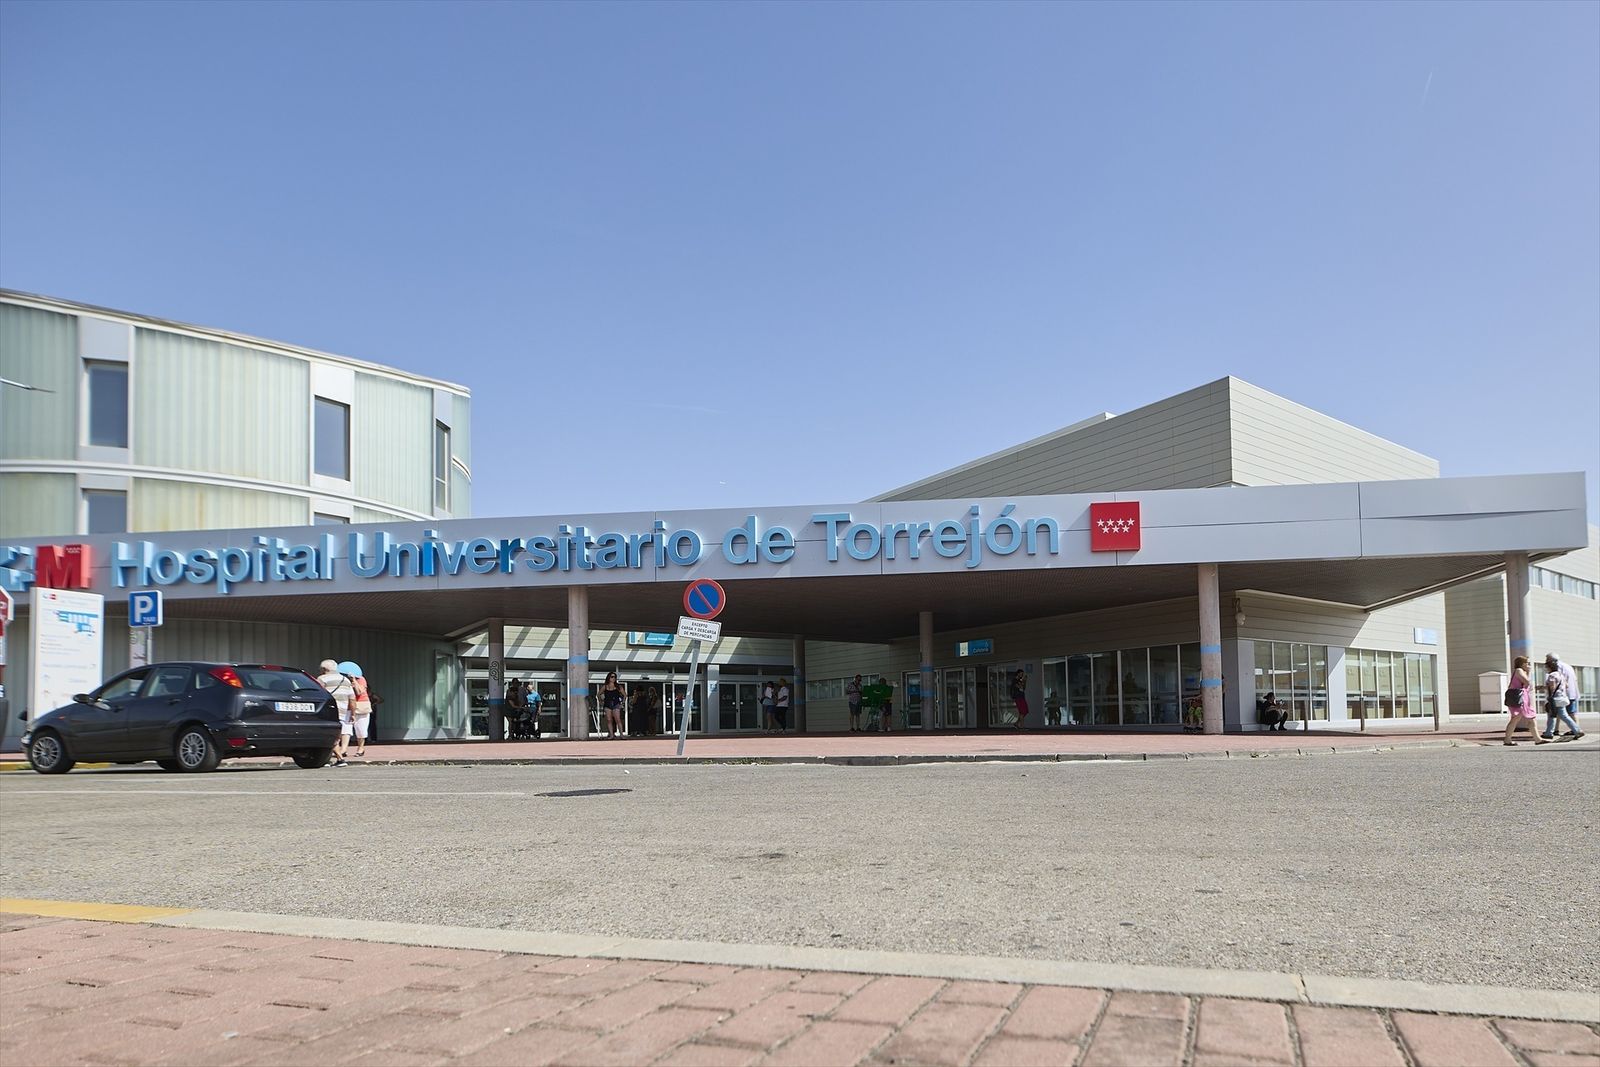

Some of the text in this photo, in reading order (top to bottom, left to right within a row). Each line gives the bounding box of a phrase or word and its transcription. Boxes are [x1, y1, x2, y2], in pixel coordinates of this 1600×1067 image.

[112, 504, 1059, 594] Hospital Universitario de Torrejón
[135, 596, 154, 622] P
